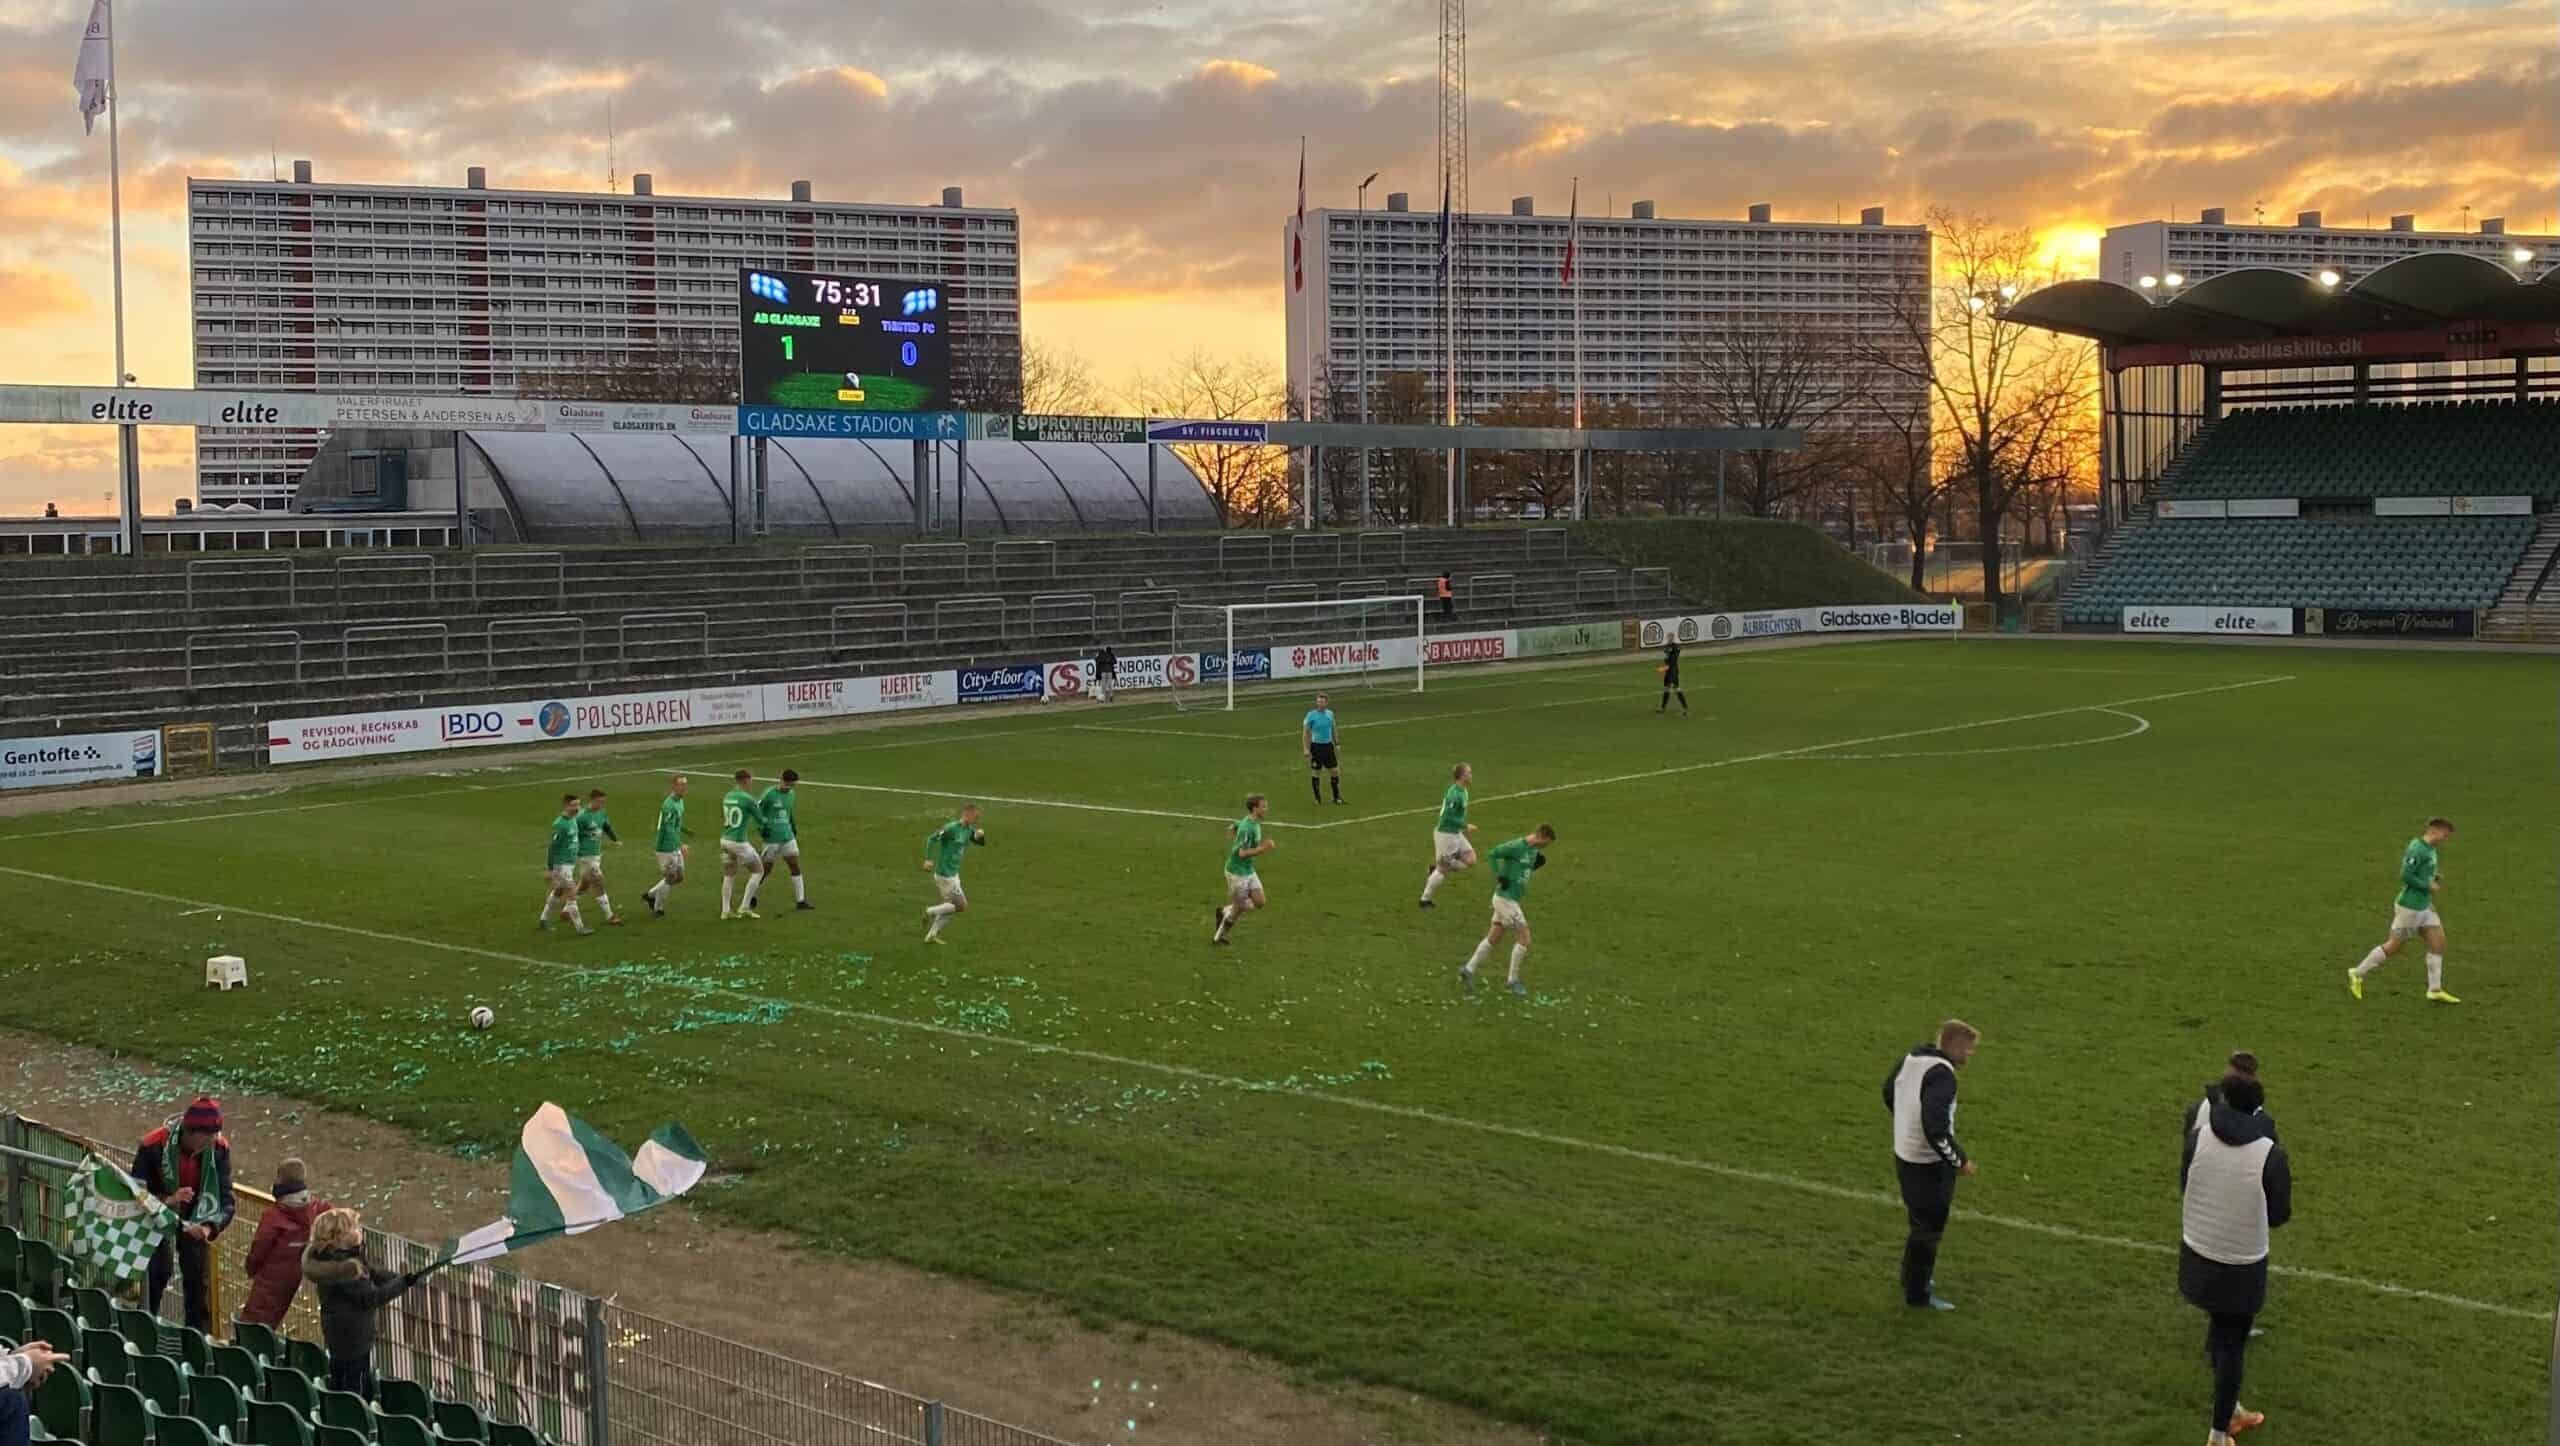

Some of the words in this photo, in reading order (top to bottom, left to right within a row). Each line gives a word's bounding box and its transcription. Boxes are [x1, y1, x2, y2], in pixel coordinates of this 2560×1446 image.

[811, 279, 881, 307] 75:31
[754, 312, 768, 325] AB
[769, 313, 821, 328] GLADSAXE
[922, 323, 936, 334] FC
[781, 335, 793, 360] 1
[902, 341, 917, 366] 0
[91, 397, 153, 420] elite
[221, 401, 279, 424] elite
[337, 409, 406, 420] PETERSEN
[411, 411, 420, 420] &
[423, 411, 492, 422] ANDERSEN
[495, 413, 516, 422] A/S
[747, 412, 836, 432] GLADSAXE
[842, 416, 914, 433] STADION
[1017, 415, 1142, 432] SØPROMENADEN
[1200, 427, 1239, 437] FISCHER
[1039, 431, 1074, 441] DANSK
[1078, 432, 1124, 442] FROKOST
[2130, 611, 2170, 628] elite
[2214, 612, 2256, 630] elite
[1309, 645, 1345, 666] MENY
[1431, 640, 1503, 659] BAUHAUS
[787, 682, 832, 703] HJERTE
[880, 675, 922, 695] HJERTE
[449, 711, 503, 735] BDO
[577, 699, 691, 730] PØLSEBAREN
[302, 725, 358, 738] REVISION,
[361, 719, 418, 733] REGNSKAB
[302, 740, 320, 750] OG
[323, 734, 395, 749] RÅDGIVNING
[4, 746, 80, 765] Gentofte
